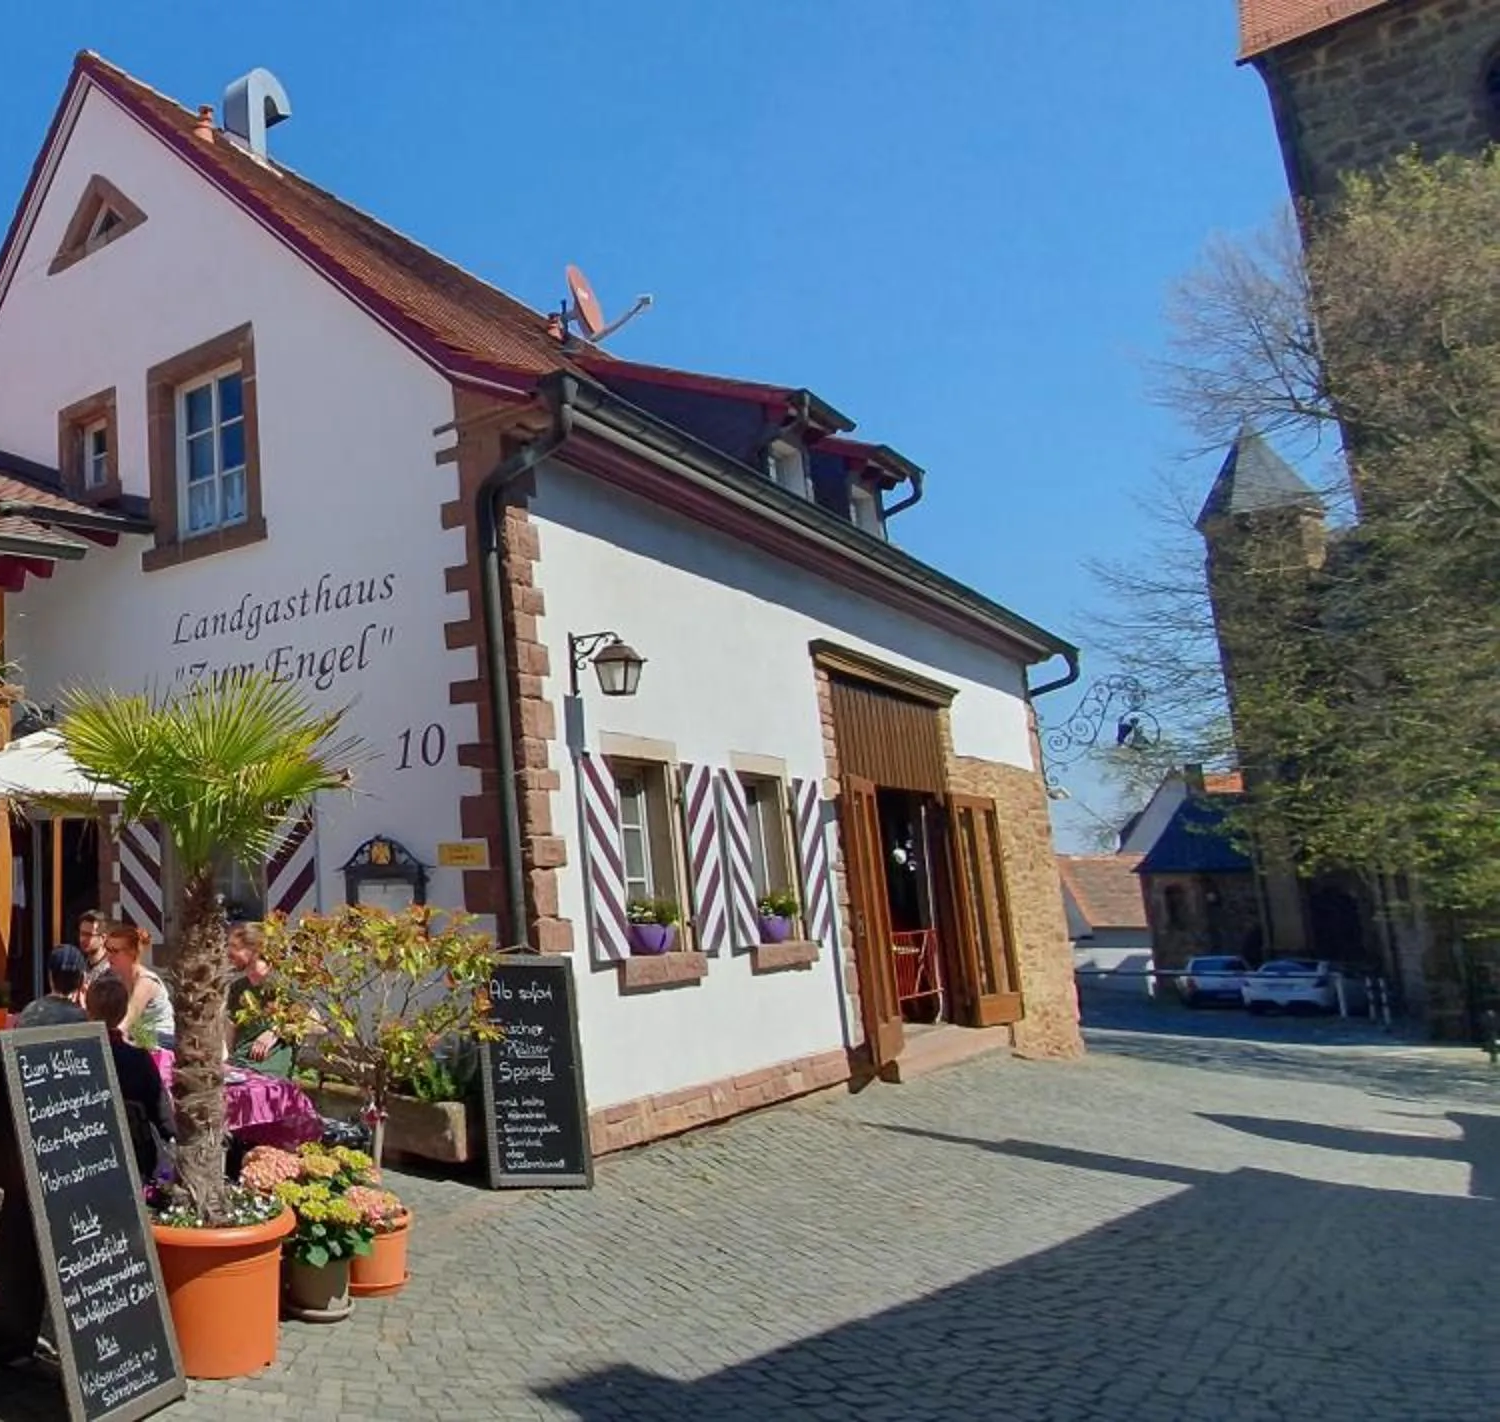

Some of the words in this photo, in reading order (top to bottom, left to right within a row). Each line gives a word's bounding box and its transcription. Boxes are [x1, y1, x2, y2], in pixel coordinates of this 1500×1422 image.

[172, 572, 396, 645] Landgasthaus
[394, 722, 447, 771] 10
[489, 979, 513, 1000] Ab
[20, 1055, 49, 1080] Zum
[49, 1048, 89, 1076] Kaffee
